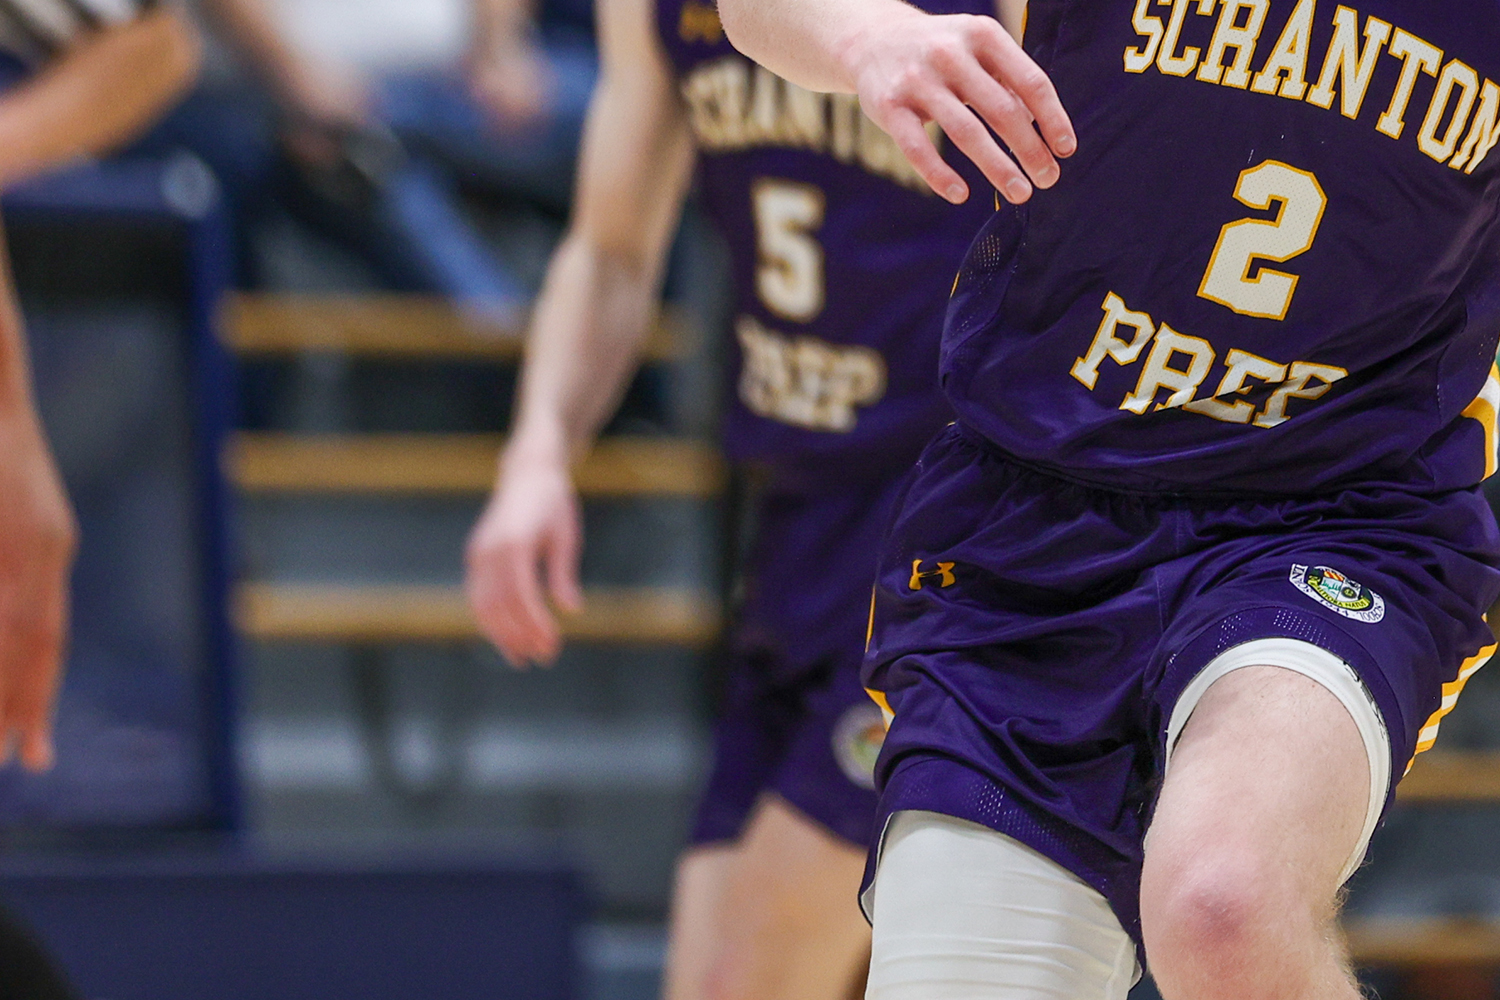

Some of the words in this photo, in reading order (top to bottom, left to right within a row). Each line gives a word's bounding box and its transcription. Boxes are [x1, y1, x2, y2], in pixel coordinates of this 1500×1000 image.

[752, 175, 826, 323] 5
[1196, 159, 1327, 320] 2
[1070, 291, 1348, 429] PREP
